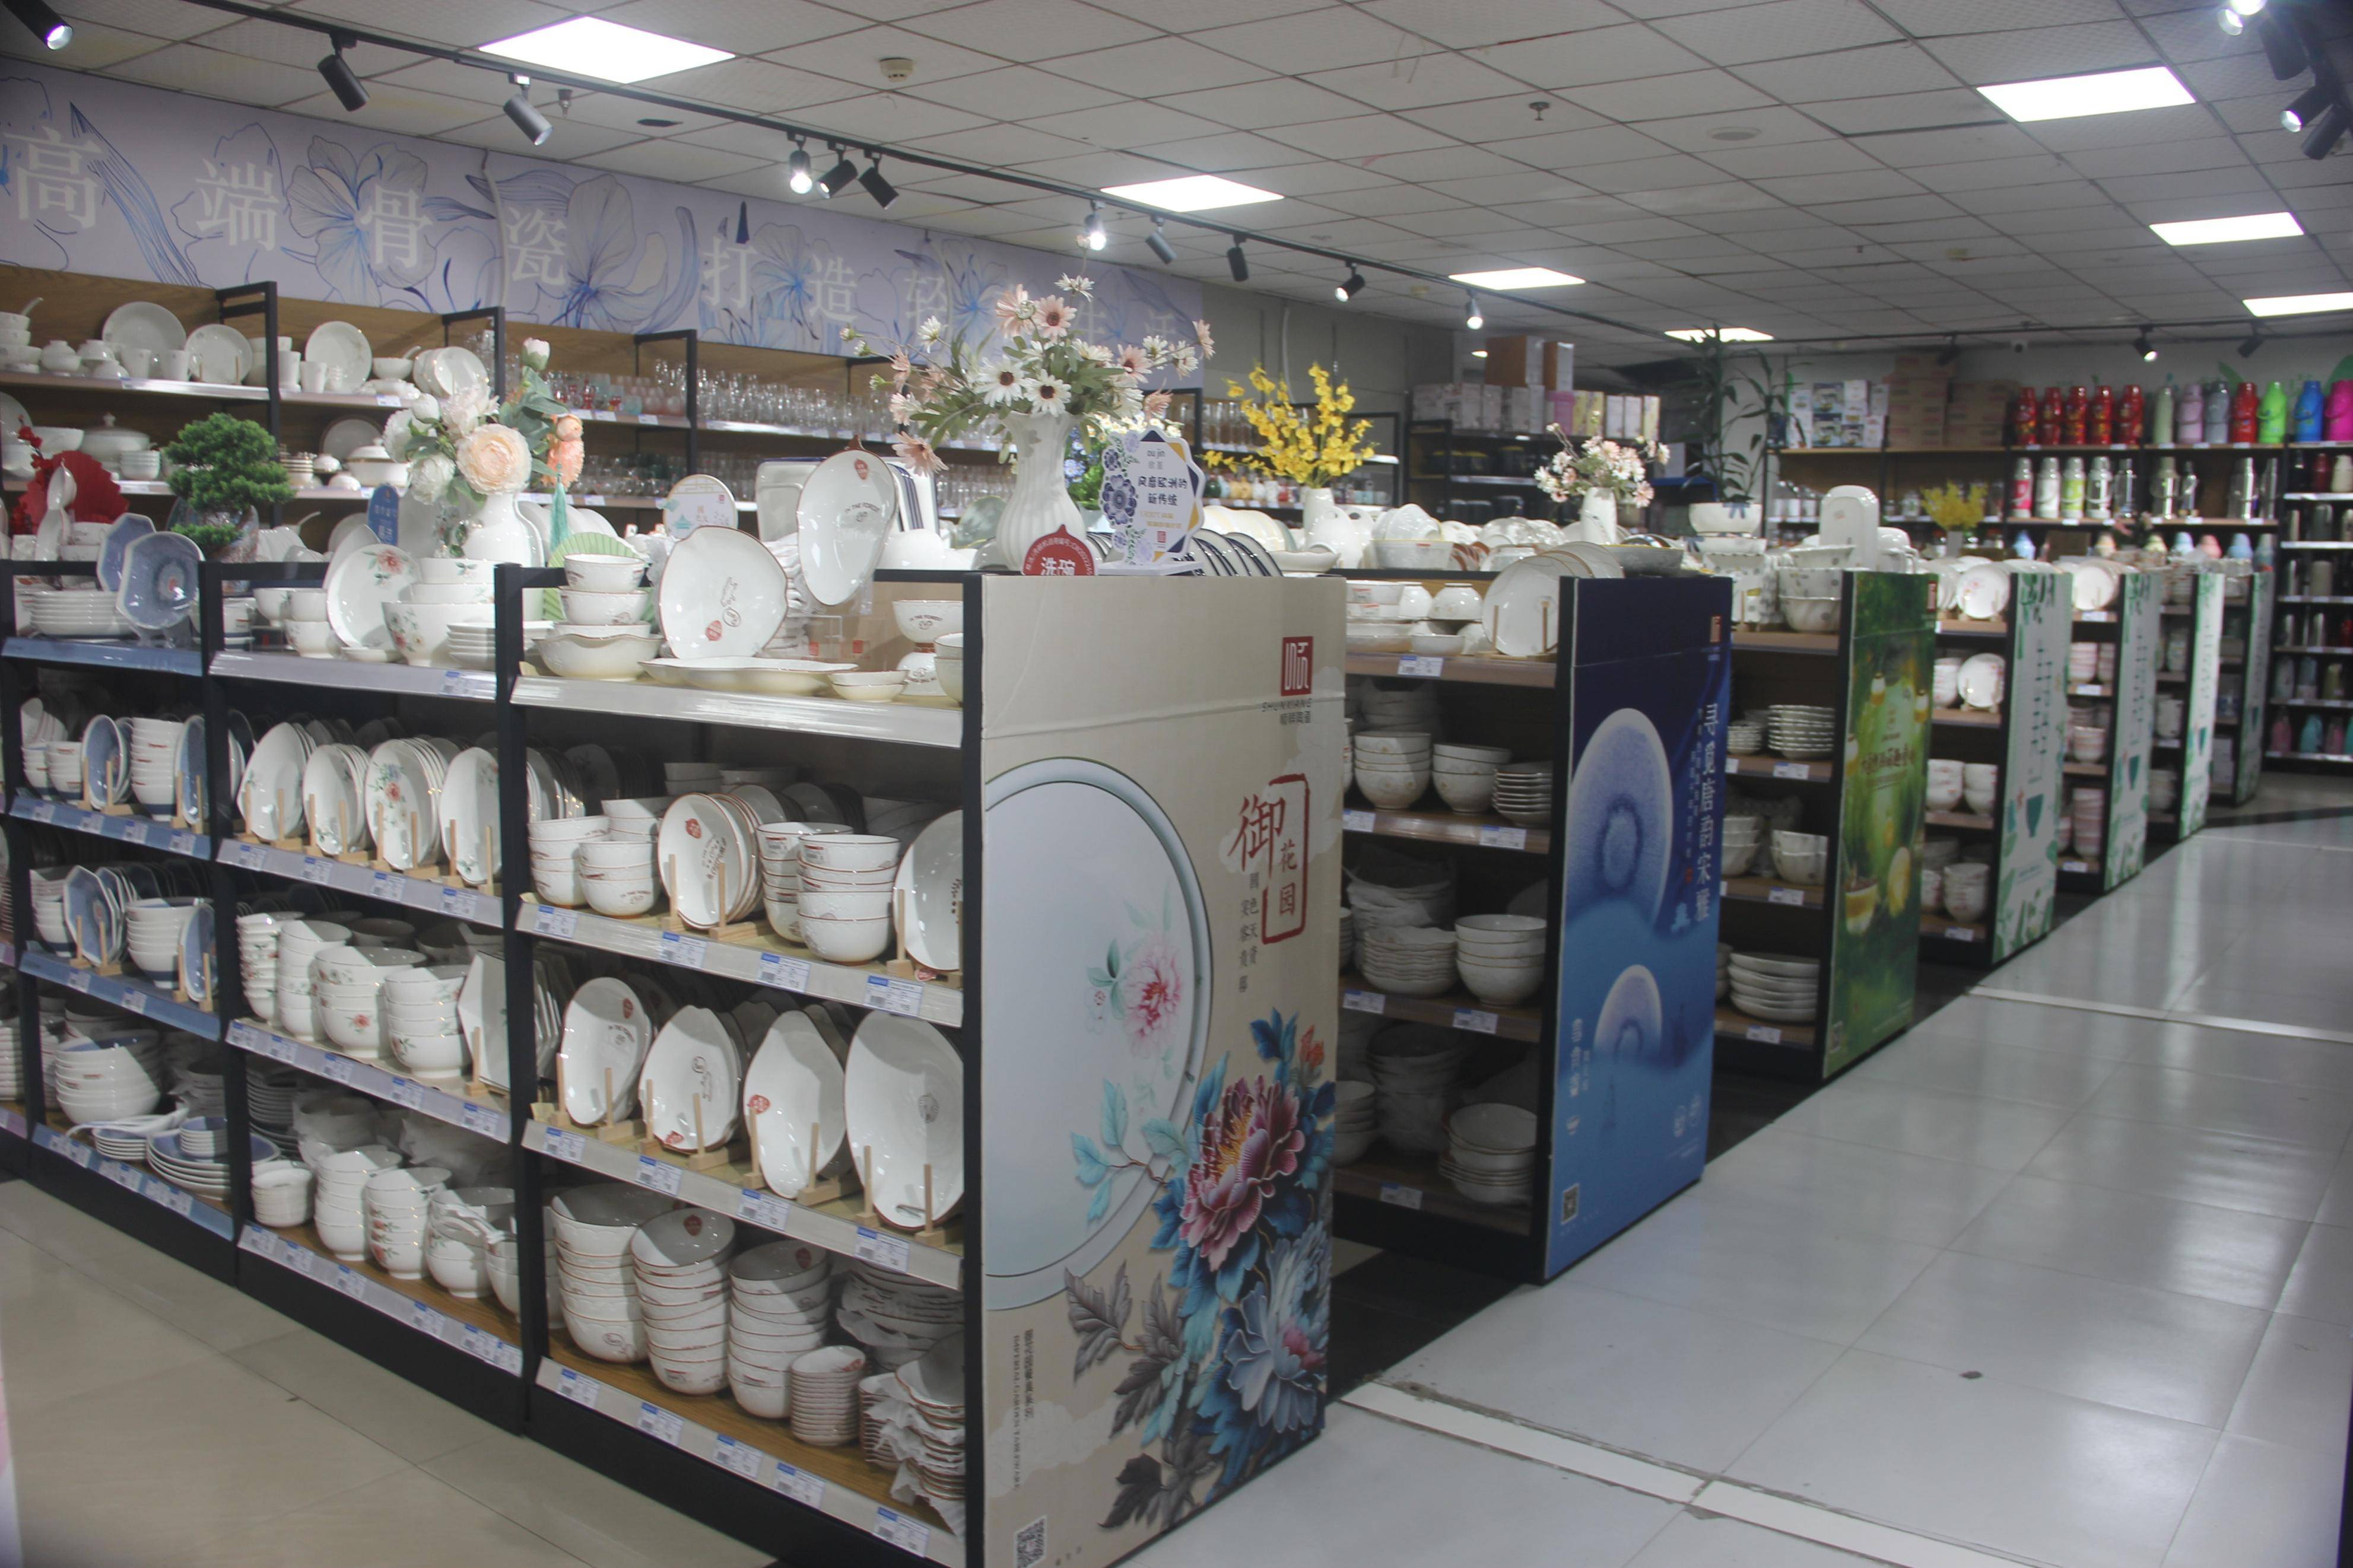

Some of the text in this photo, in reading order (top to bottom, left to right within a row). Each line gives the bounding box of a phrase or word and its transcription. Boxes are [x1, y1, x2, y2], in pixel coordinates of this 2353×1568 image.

[4, 126, 568, 286] 高端骨瓷
[1228, 794, 1297, 916] 御 花园
